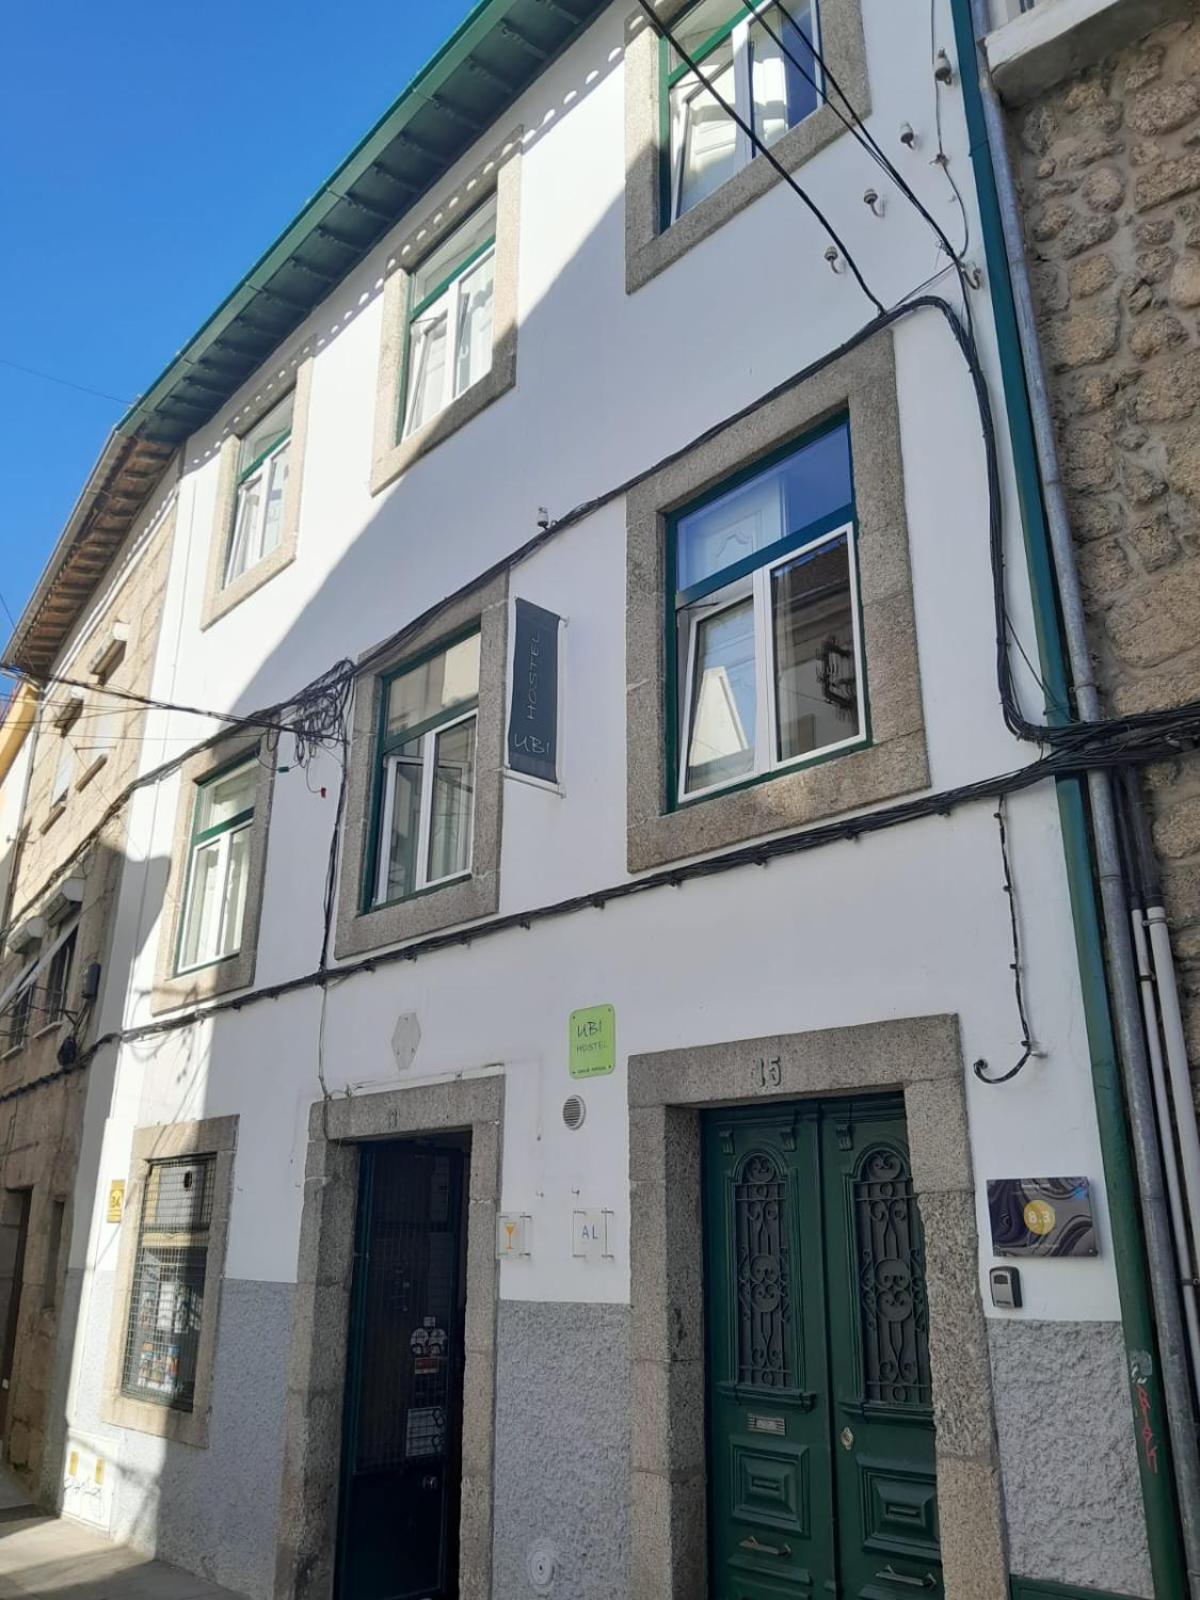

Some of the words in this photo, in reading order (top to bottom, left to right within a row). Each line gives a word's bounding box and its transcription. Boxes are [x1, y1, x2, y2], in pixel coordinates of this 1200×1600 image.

[527, 630, 542, 720] HOSTEL
[512, 734, 551, 754] UBI
[577, 1019, 602, 1038] UBI
[576, 1040, 608, 1054] HOSTEL
[758, 1055, 782, 1088] 15
[582, 1224, 599, 1240] AL
